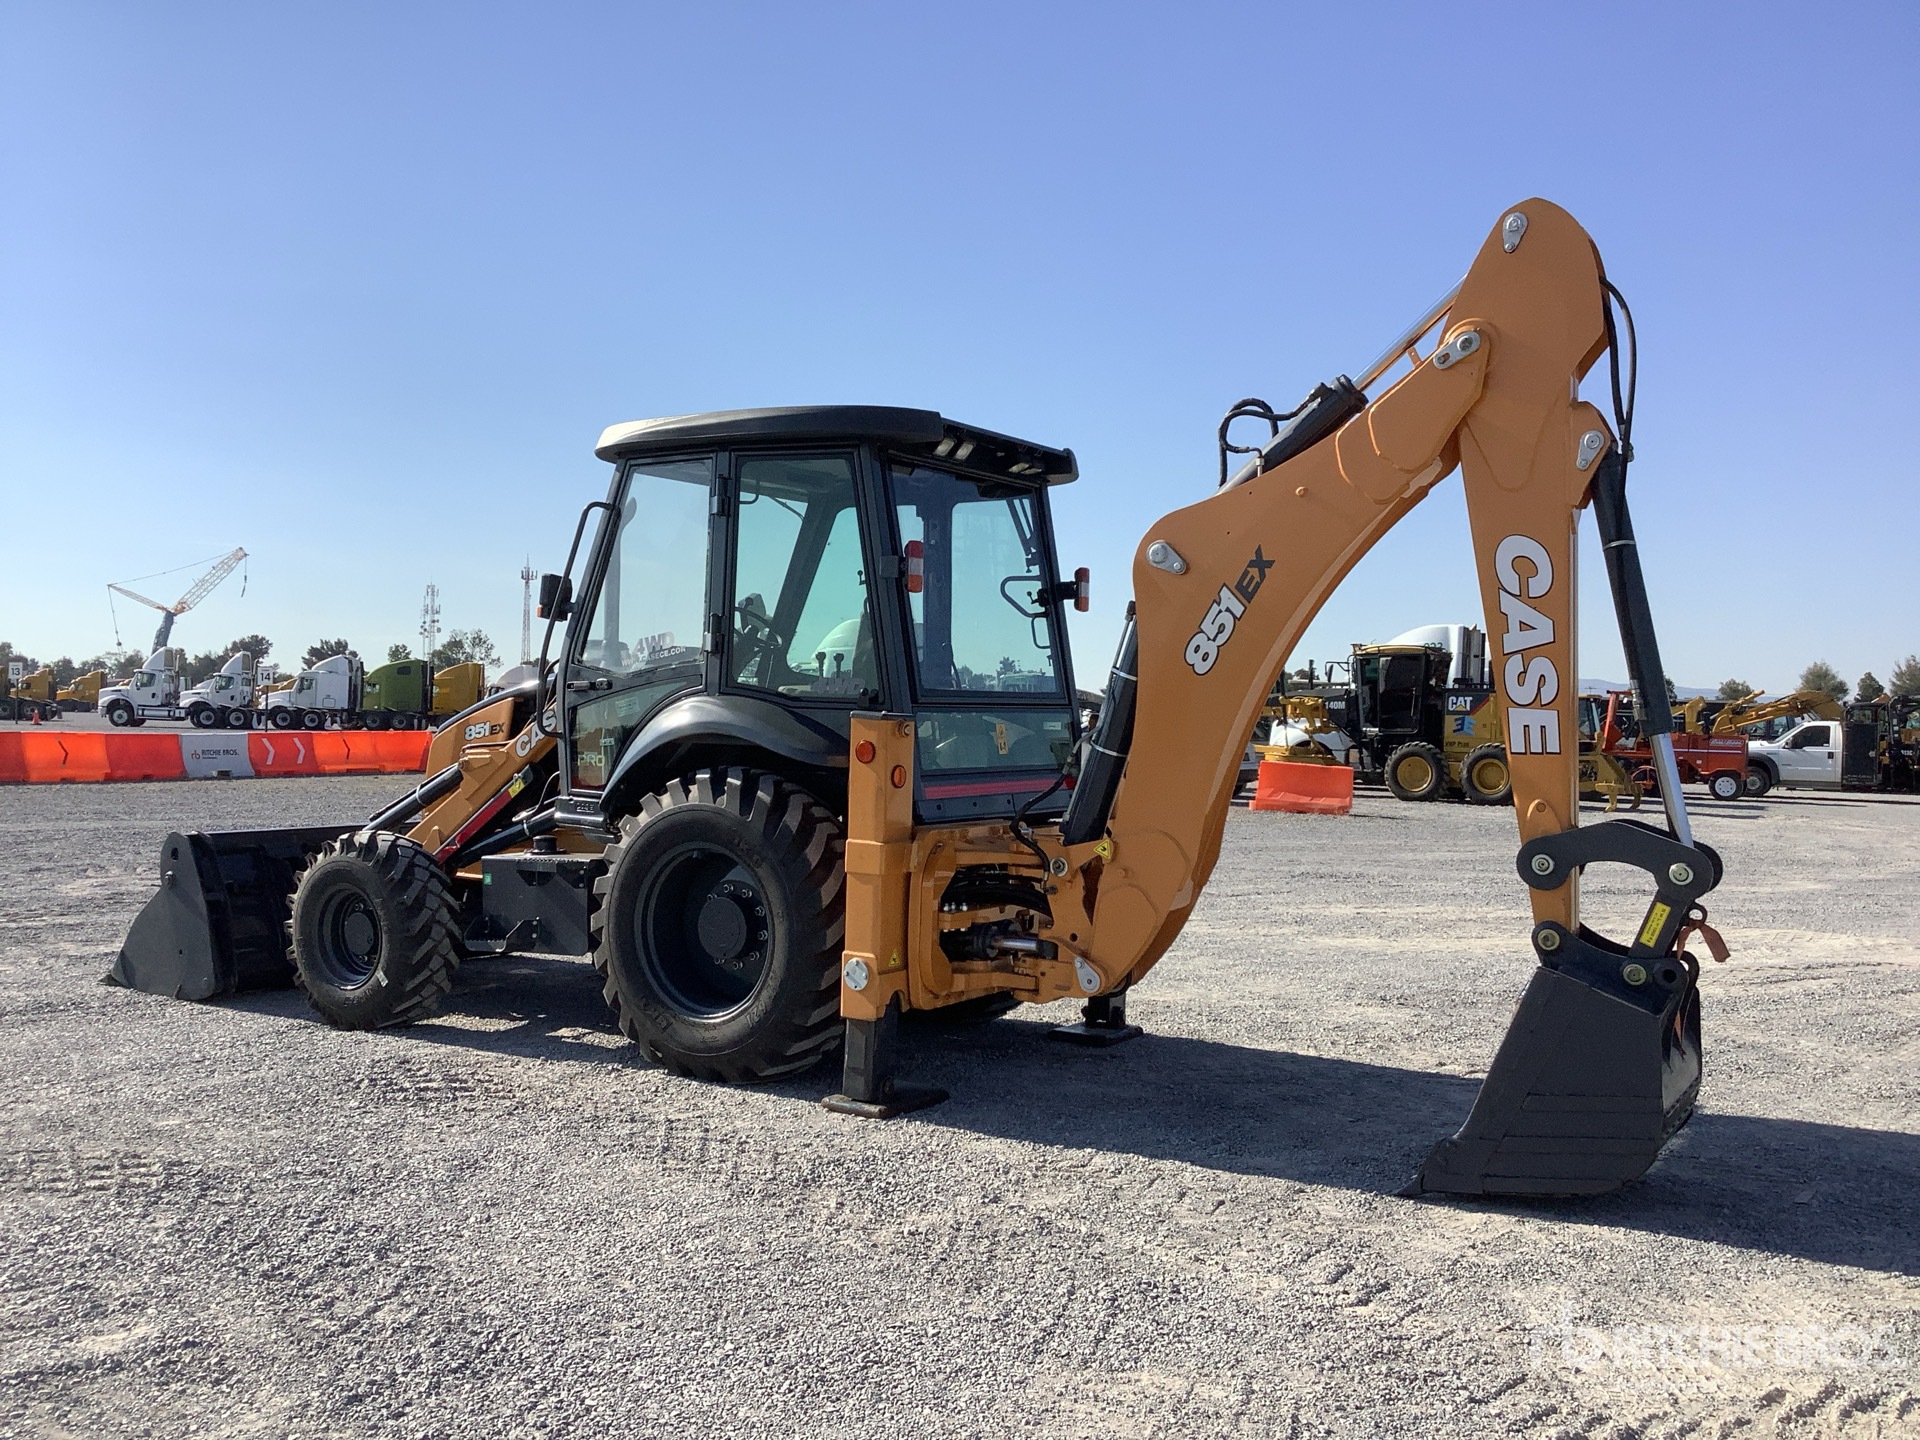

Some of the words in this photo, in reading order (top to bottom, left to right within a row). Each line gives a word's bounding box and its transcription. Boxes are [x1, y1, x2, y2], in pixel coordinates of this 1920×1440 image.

[632, 631, 676, 655] 4WD
[1494, 533, 1562, 755] CASE
[11, 667, 20, 676] 13
[260, 672, 271, 682] 14
[1325, 701, 1346, 710] 140M
[1448, 696, 1473, 712] CAT
[515, 709, 557, 757] CAS
[578, 753, 605, 767] PRO
